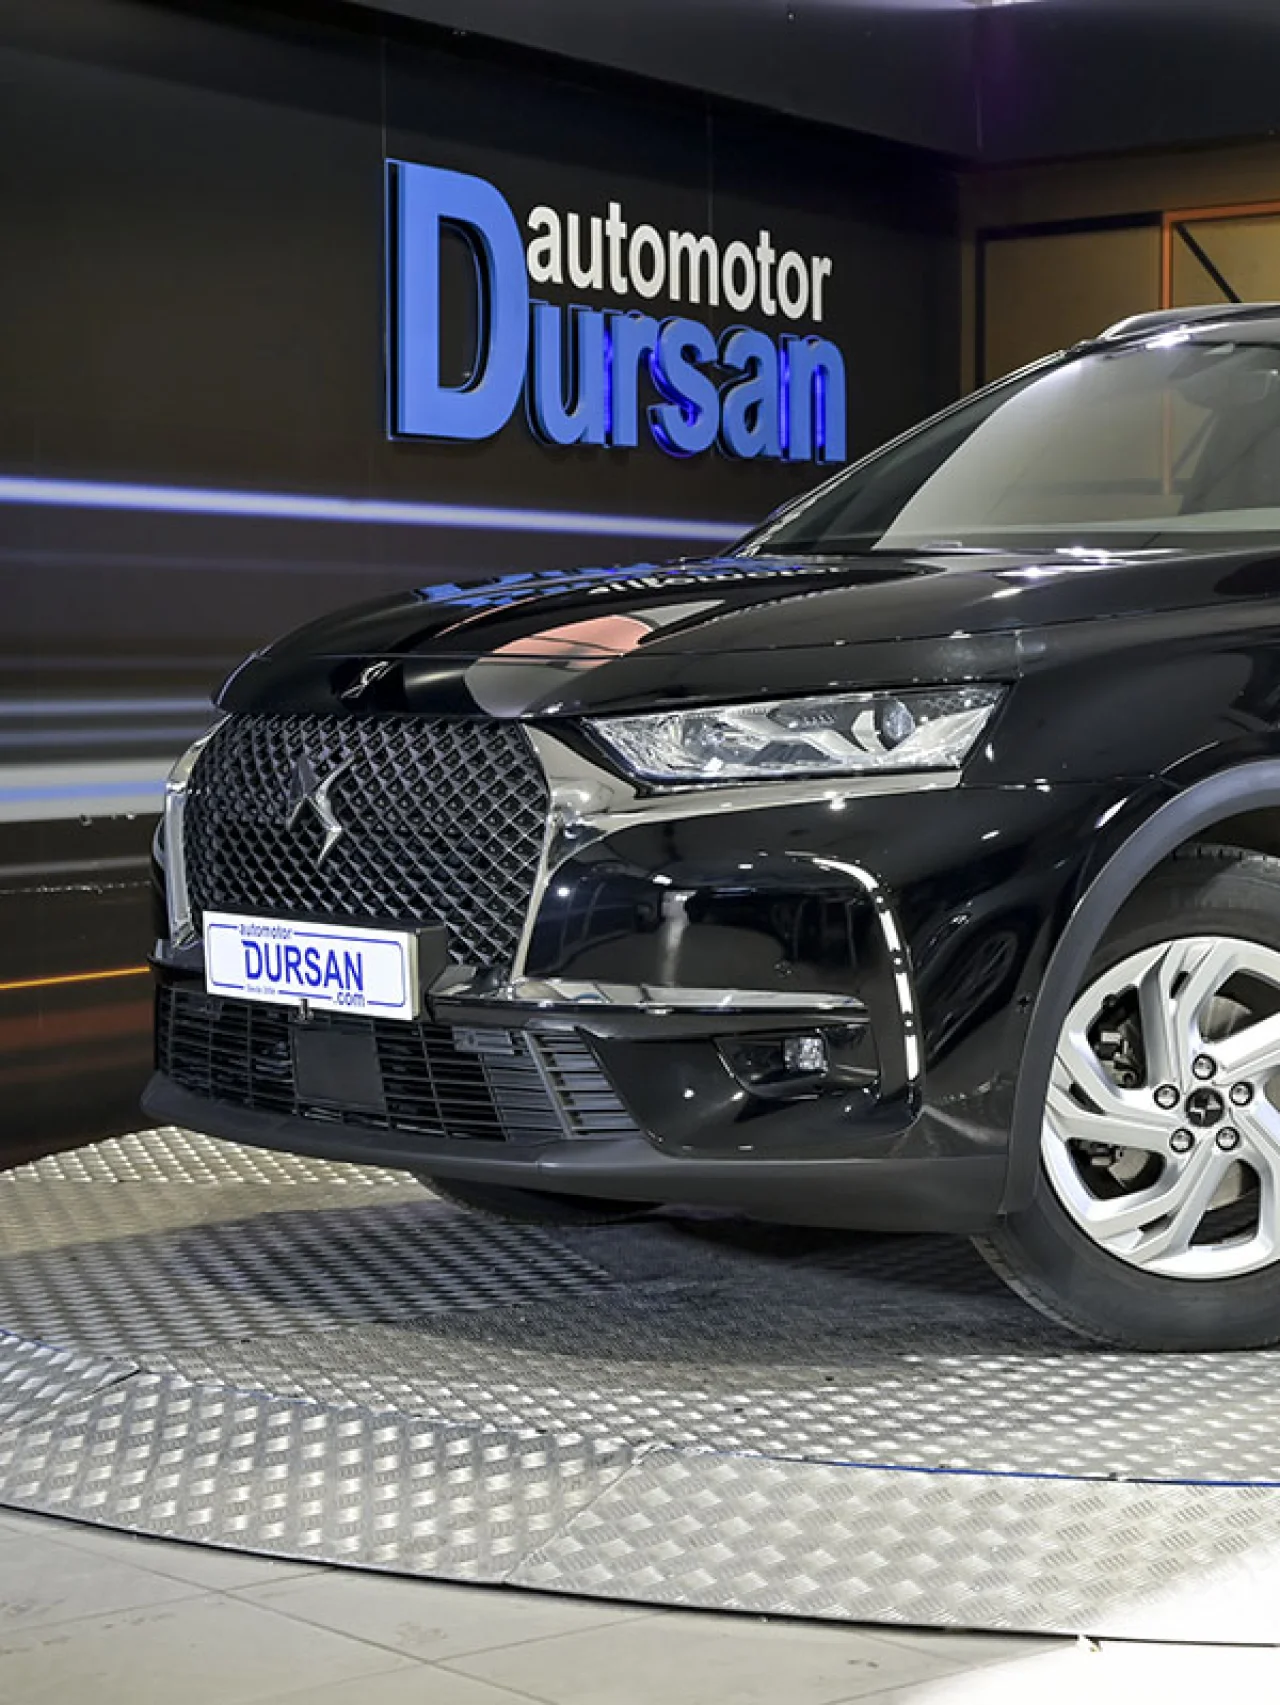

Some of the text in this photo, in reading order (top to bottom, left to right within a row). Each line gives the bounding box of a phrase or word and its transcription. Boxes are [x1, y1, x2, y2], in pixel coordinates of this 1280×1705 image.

[385, 158, 847, 464] Dursan
[527, 202, 832, 321] automotor
[241, 939, 364, 991] DURSAN
